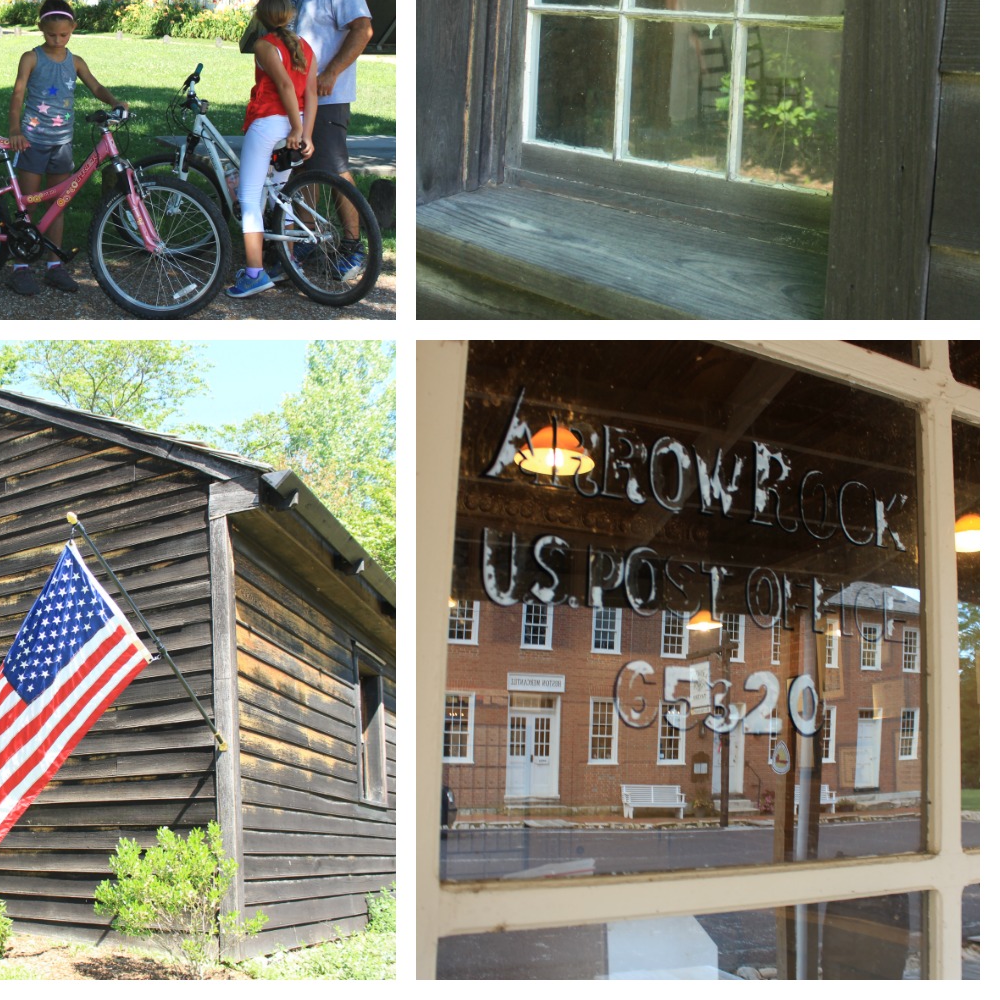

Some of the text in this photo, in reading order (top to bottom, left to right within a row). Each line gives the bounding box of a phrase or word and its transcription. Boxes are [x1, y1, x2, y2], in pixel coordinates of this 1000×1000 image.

[482, 386, 910, 553] ARROW ROCK
[587, 544, 736, 623] POST
[746, 565, 910, 645] OFFICE
[613, 659, 826, 738] 65320
